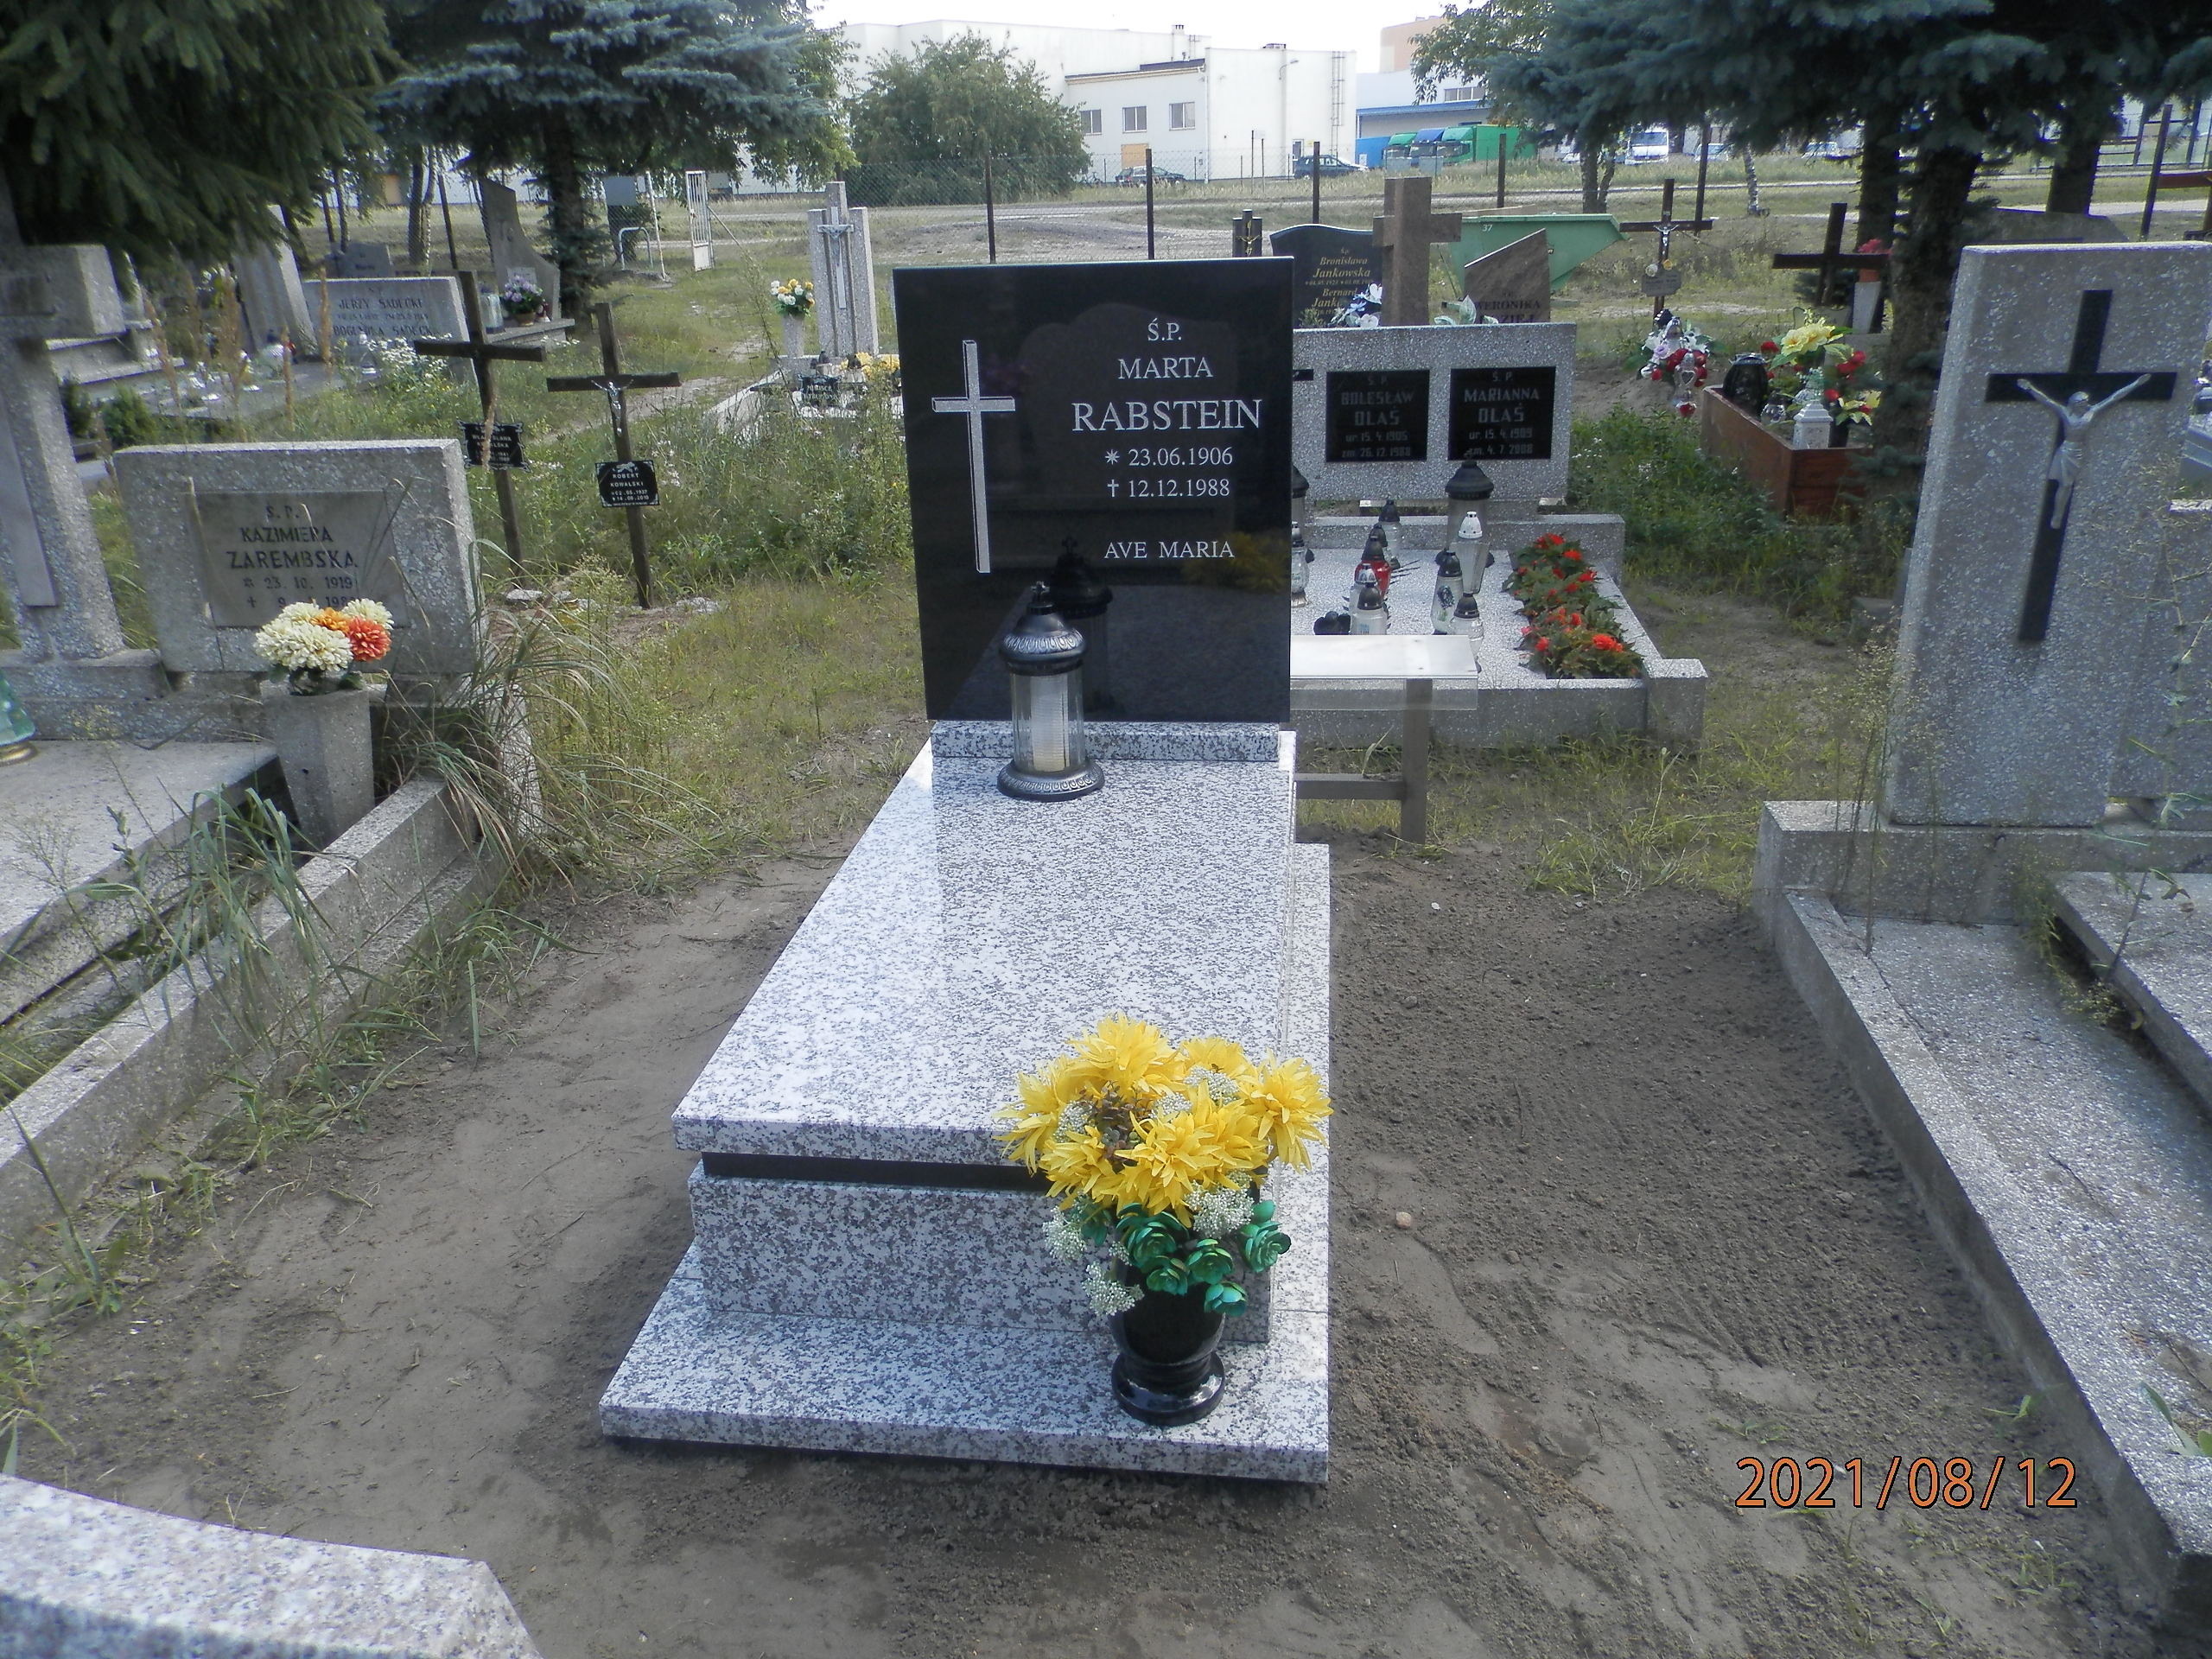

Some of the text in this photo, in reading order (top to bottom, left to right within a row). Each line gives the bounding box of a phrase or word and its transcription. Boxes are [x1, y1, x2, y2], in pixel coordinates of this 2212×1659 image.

[1313, 267, 1371, 277] Jankowska
[1117, 357, 1214, 380] MARTA
[1340, 390, 1414, 405] BOLESŁAW
[1464, 387, 1540, 403] MARIANNA
[1071, 398, 1262, 432] RABSTEIN
[1128, 447, 1234, 467] 23.06.1906
[1128, 479, 1230, 498] 12.12.1988
[240, 525, 334, 543] KAZIMIERA
[226, 550, 359, 569] ZAREMBSKA
[1103, 541, 1235, 560] AVE MARIA
[325, 576, 353, 589] 1919
